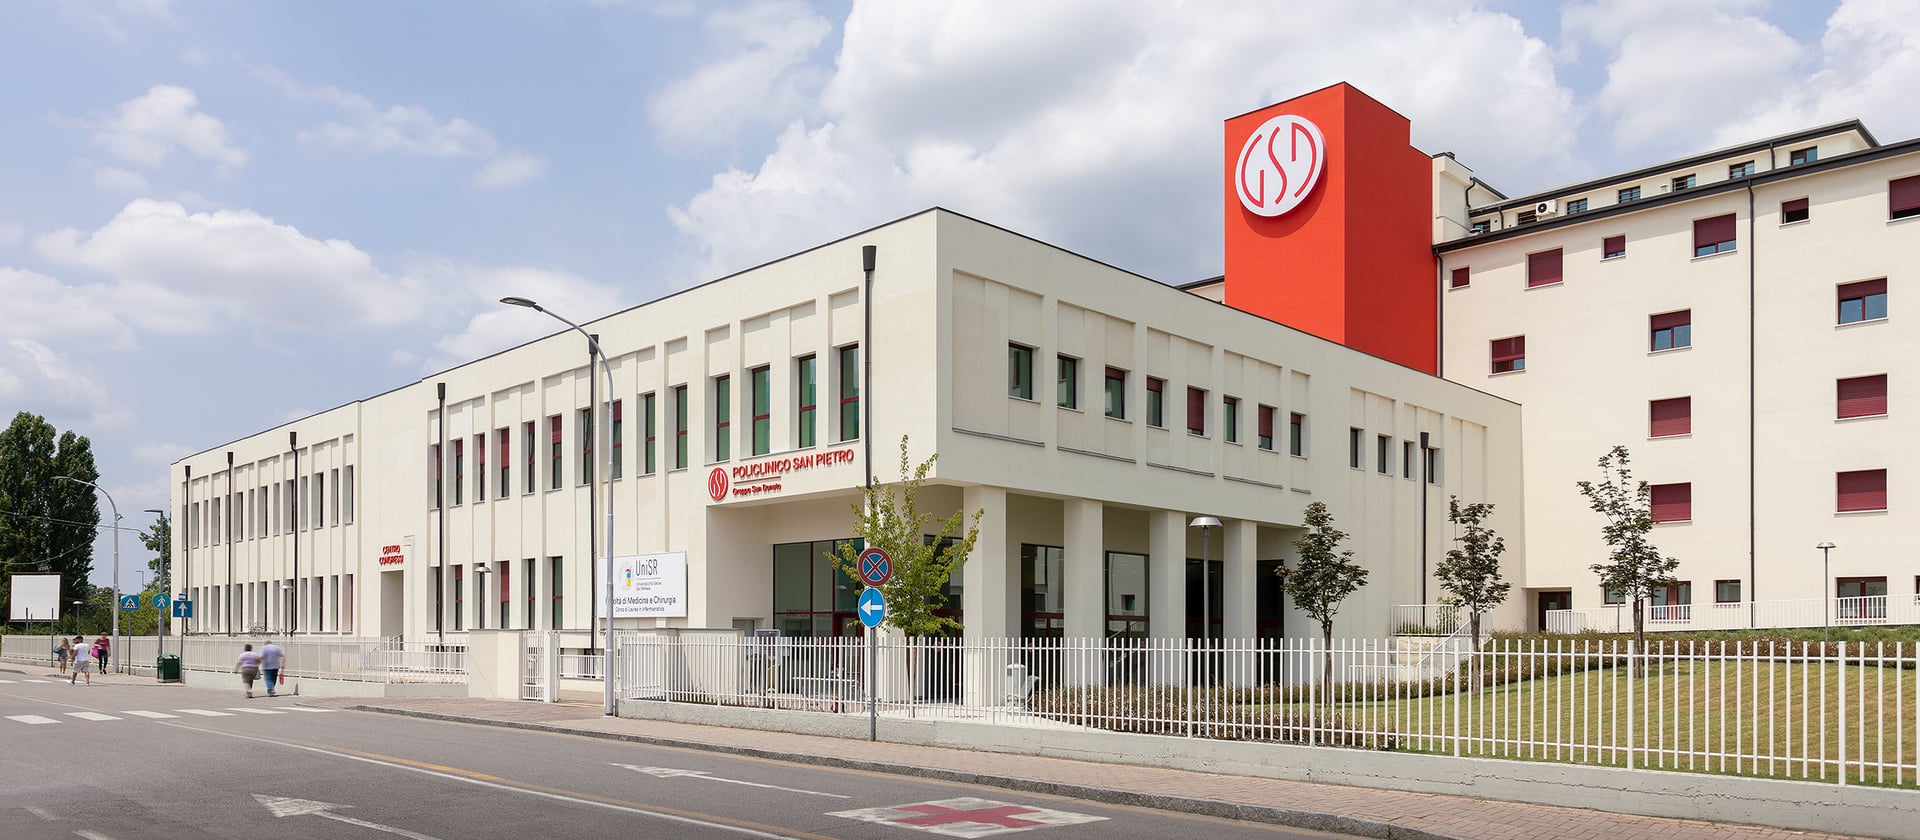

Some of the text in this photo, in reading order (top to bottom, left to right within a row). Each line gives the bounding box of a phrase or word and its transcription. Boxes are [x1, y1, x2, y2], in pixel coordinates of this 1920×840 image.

[1240, 122, 1317, 208] GSD
[733, 449, 854, 478] POLICLINICO SAN PIETRO
[733, 483, 781, 496] Gruppo San Donato
[383, 545, 401, 555] CENTRO
[379, 555, 404, 566] CONGRESSI
[635, 559, 658, 576] UniSR
[622, 597, 627, 605] di
[628, 596, 649, 605] Medicina
[654, 595, 676, 606] Chirurgia
